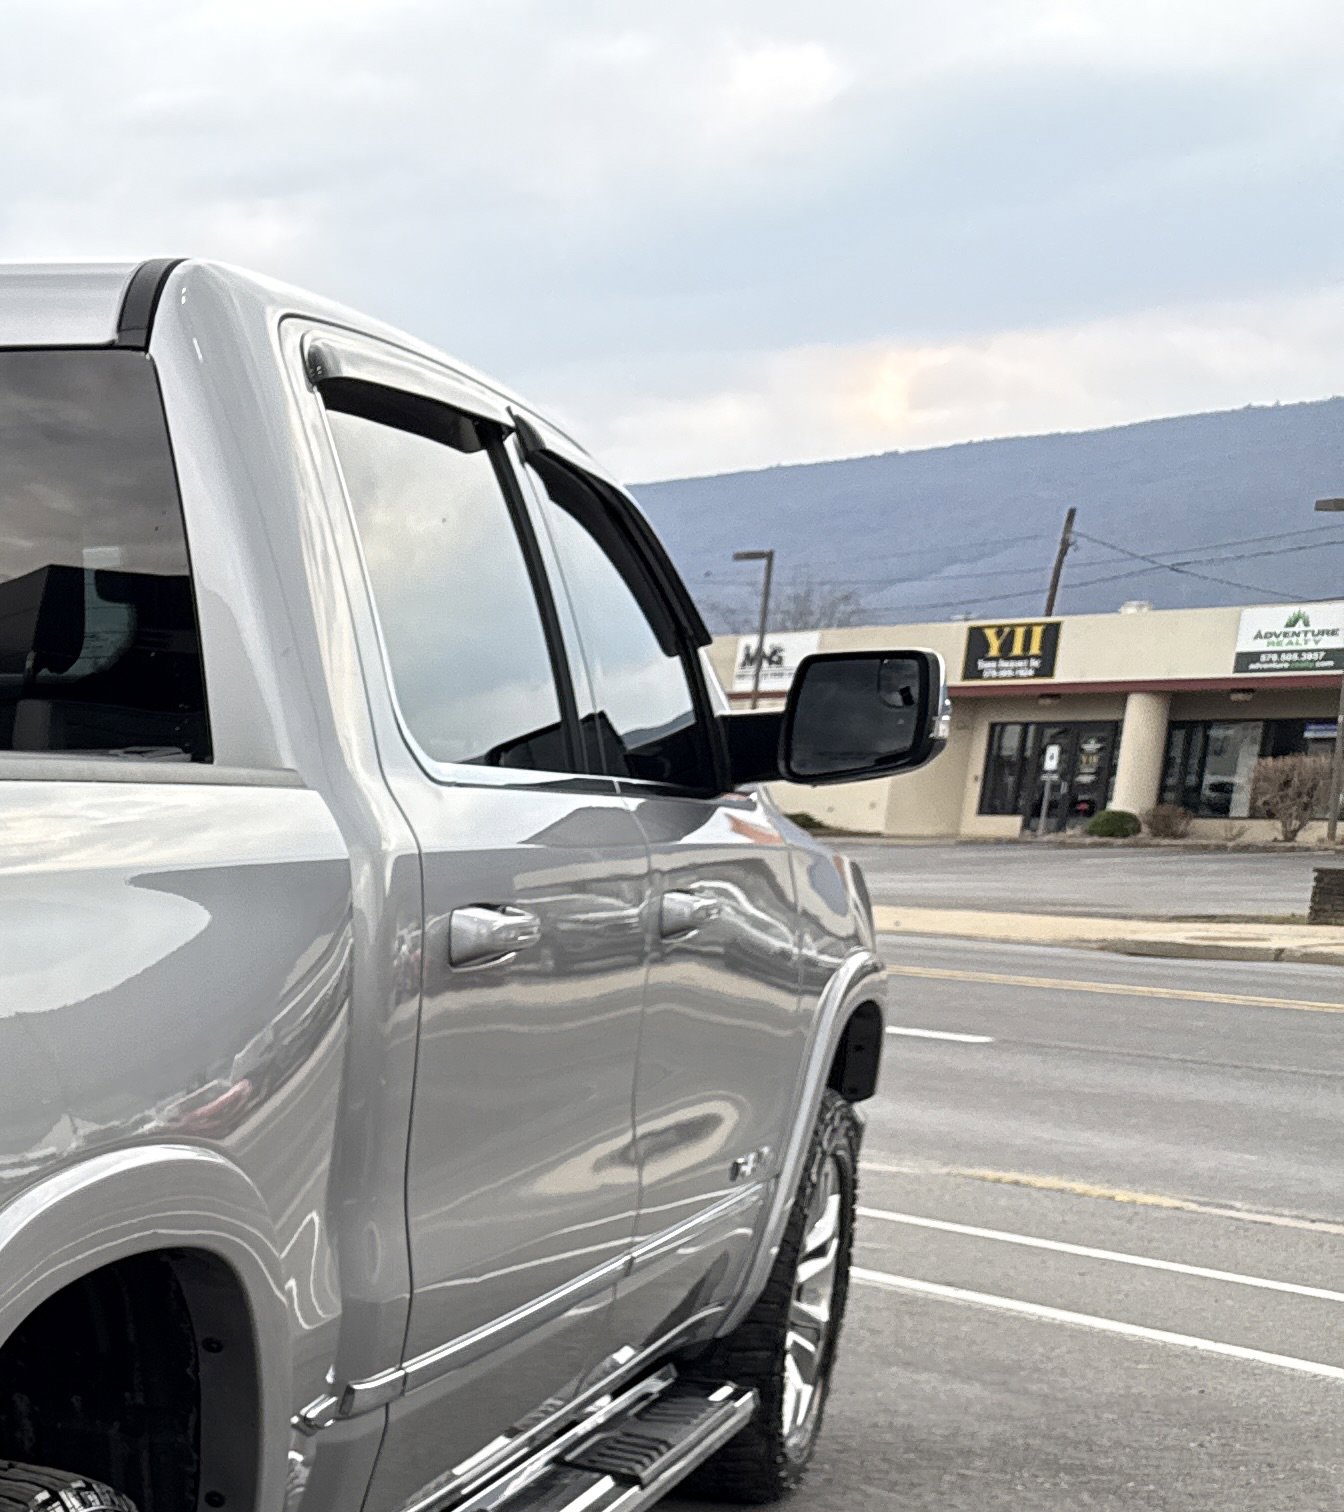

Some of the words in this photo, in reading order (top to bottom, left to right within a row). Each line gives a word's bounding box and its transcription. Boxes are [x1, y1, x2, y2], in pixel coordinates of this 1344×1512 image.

[1253, 627, 1340, 640] ADVENTURE
[983, 625, 1047, 657] YII
[1266, 638, 1322, 648] REALTY
